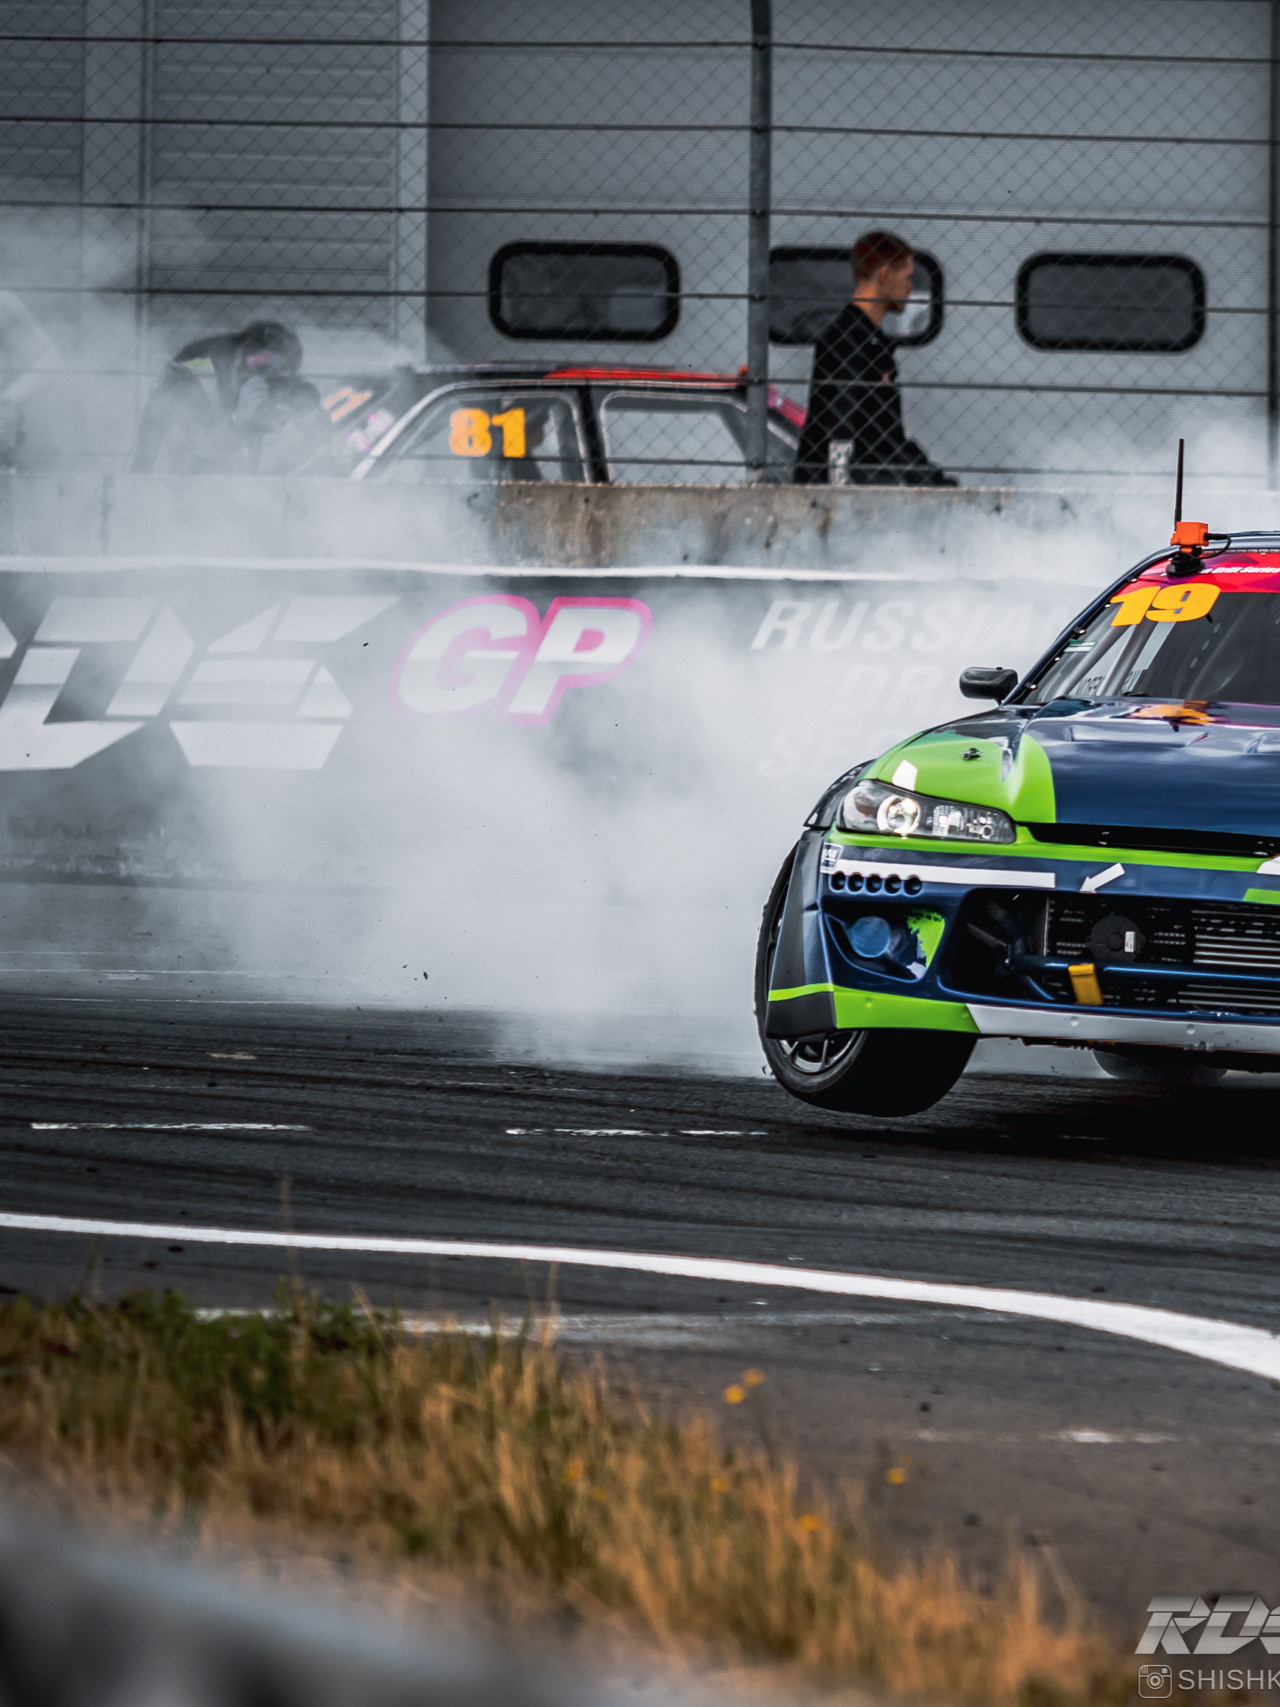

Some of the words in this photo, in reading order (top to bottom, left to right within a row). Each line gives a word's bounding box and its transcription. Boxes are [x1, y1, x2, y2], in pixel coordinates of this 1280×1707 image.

[449, 407, 527, 458] 81
[1110, 583, 1221, 627] 19
[391, 595, 655, 725] GP
